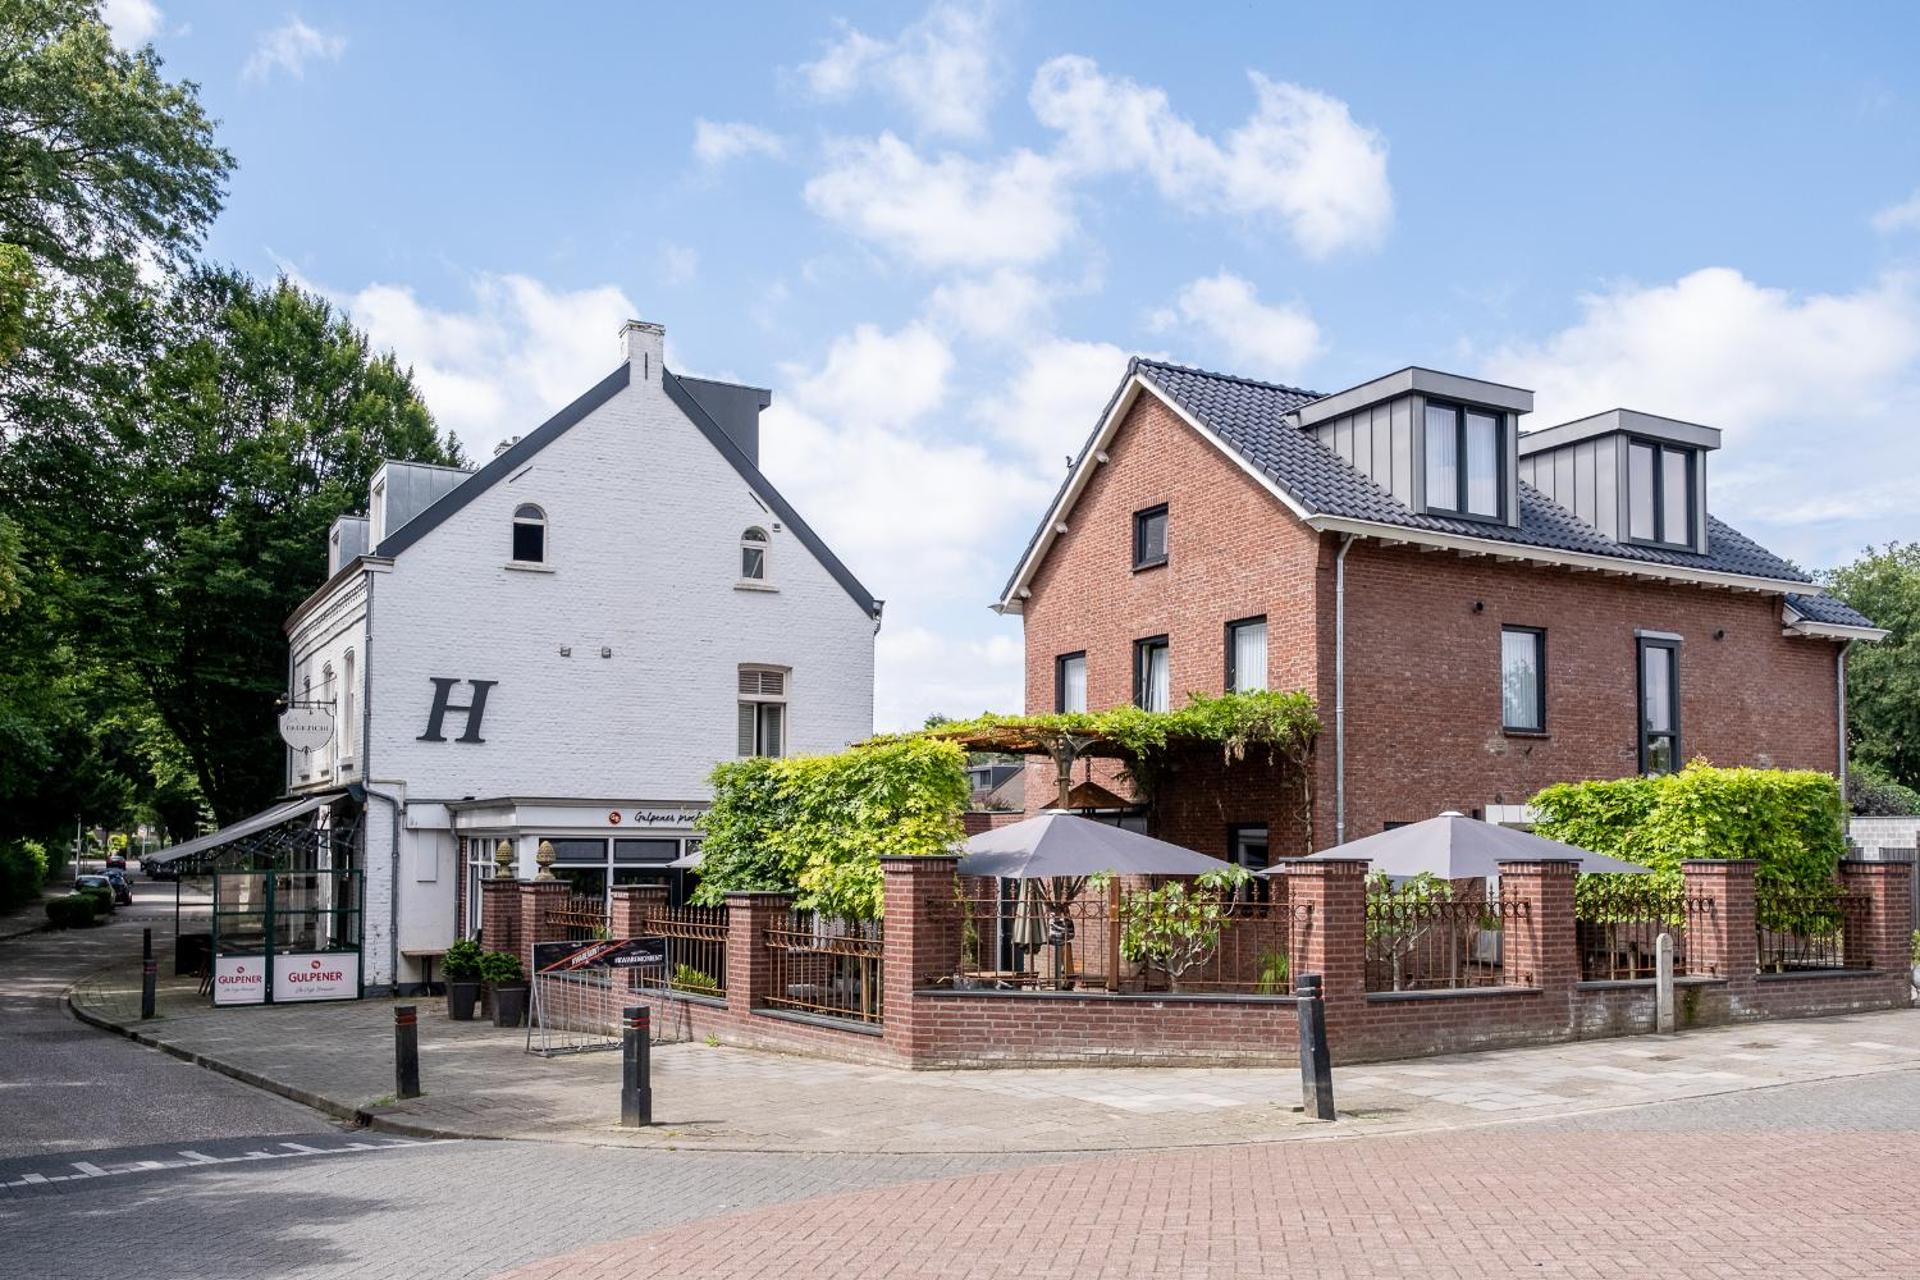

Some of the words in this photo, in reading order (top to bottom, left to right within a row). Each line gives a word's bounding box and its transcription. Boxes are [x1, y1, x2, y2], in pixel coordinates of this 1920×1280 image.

[416, 677, 499, 743] H
[218, 975, 262, 985] GULPENER
[288, 971, 343, 983] GULPENER
